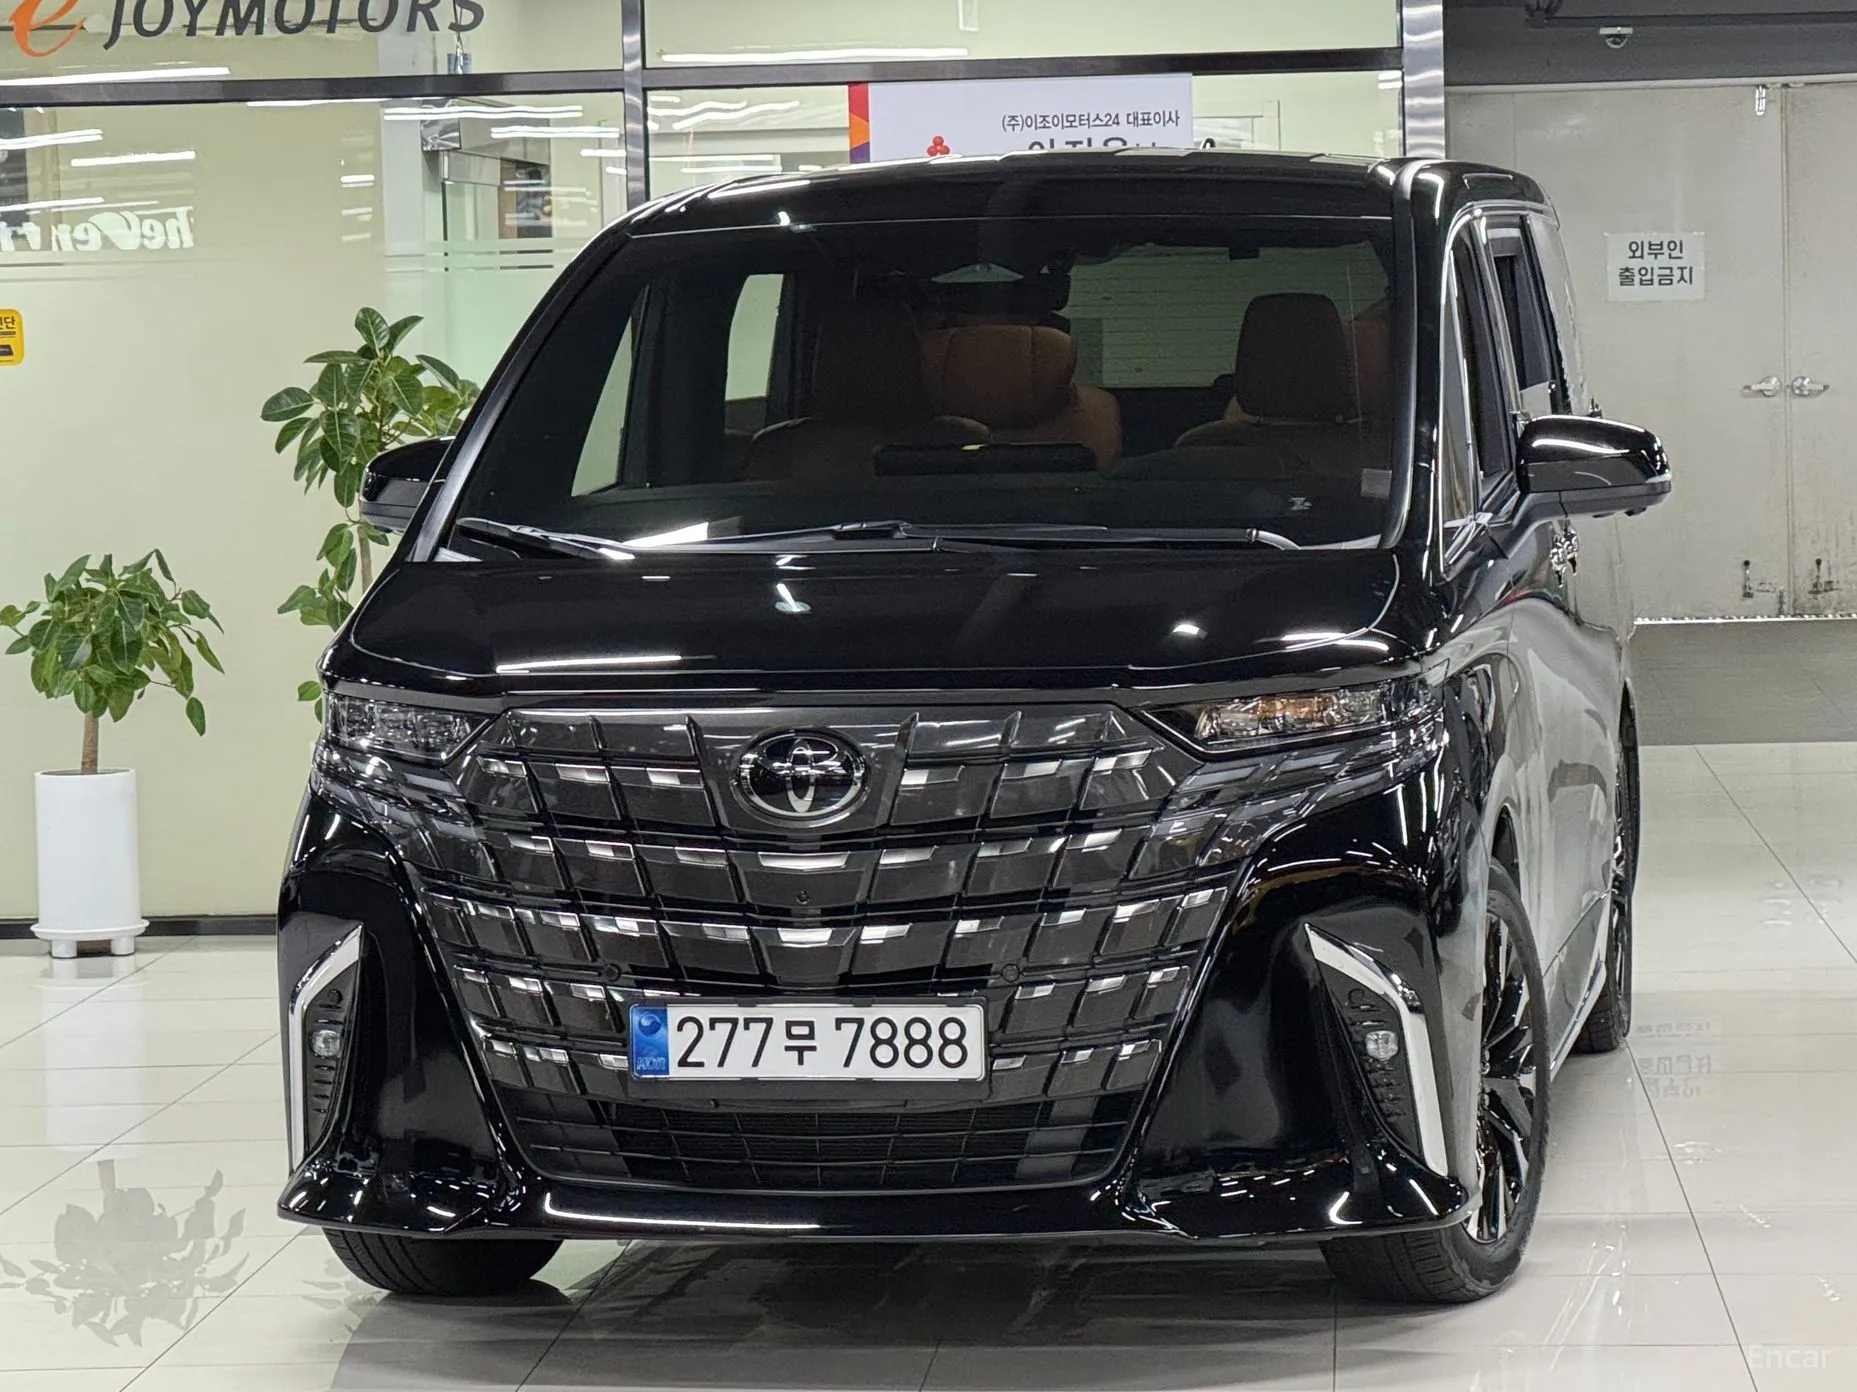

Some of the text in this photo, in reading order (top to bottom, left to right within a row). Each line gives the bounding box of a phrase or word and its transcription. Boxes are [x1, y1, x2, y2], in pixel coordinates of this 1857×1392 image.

[1002, 109, 1180, 132] (주)이조이모터스24 대표이사
[1628, 240, 1683, 259] 외부인
[1619, 266, 1693, 286] 출입금지
[835, 1016, 968, 1069] 7888
